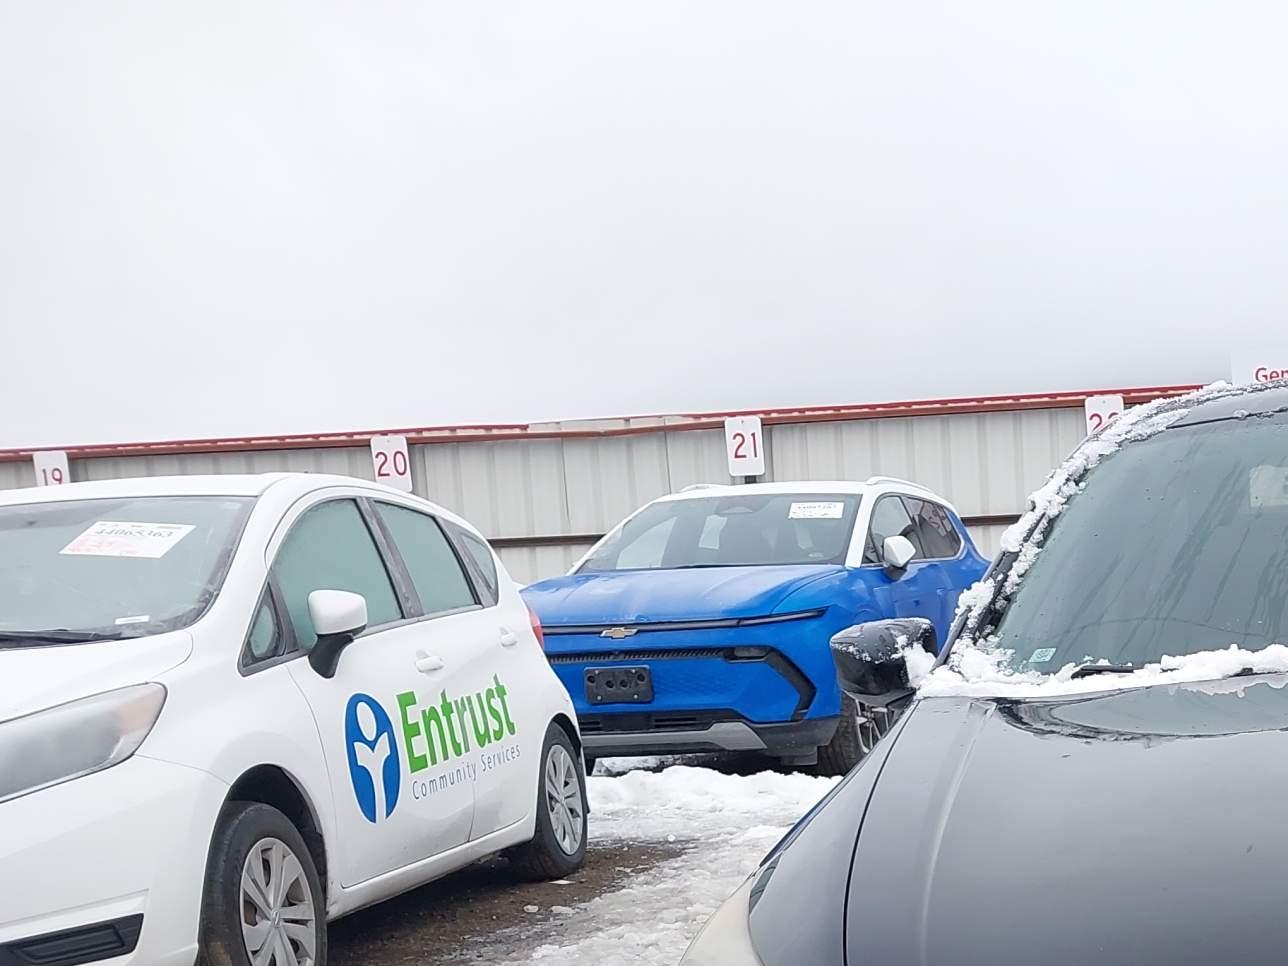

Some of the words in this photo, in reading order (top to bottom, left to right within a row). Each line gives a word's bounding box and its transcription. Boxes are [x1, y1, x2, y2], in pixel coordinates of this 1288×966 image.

[732, 432, 758, 459] 21
[42, 467, 63, 486] 19
[375, 450, 408, 477] 20
[396, 673, 516, 774] Entrust
[412, 762, 477, 800] Community
[481, 744, 521, 772] Services
